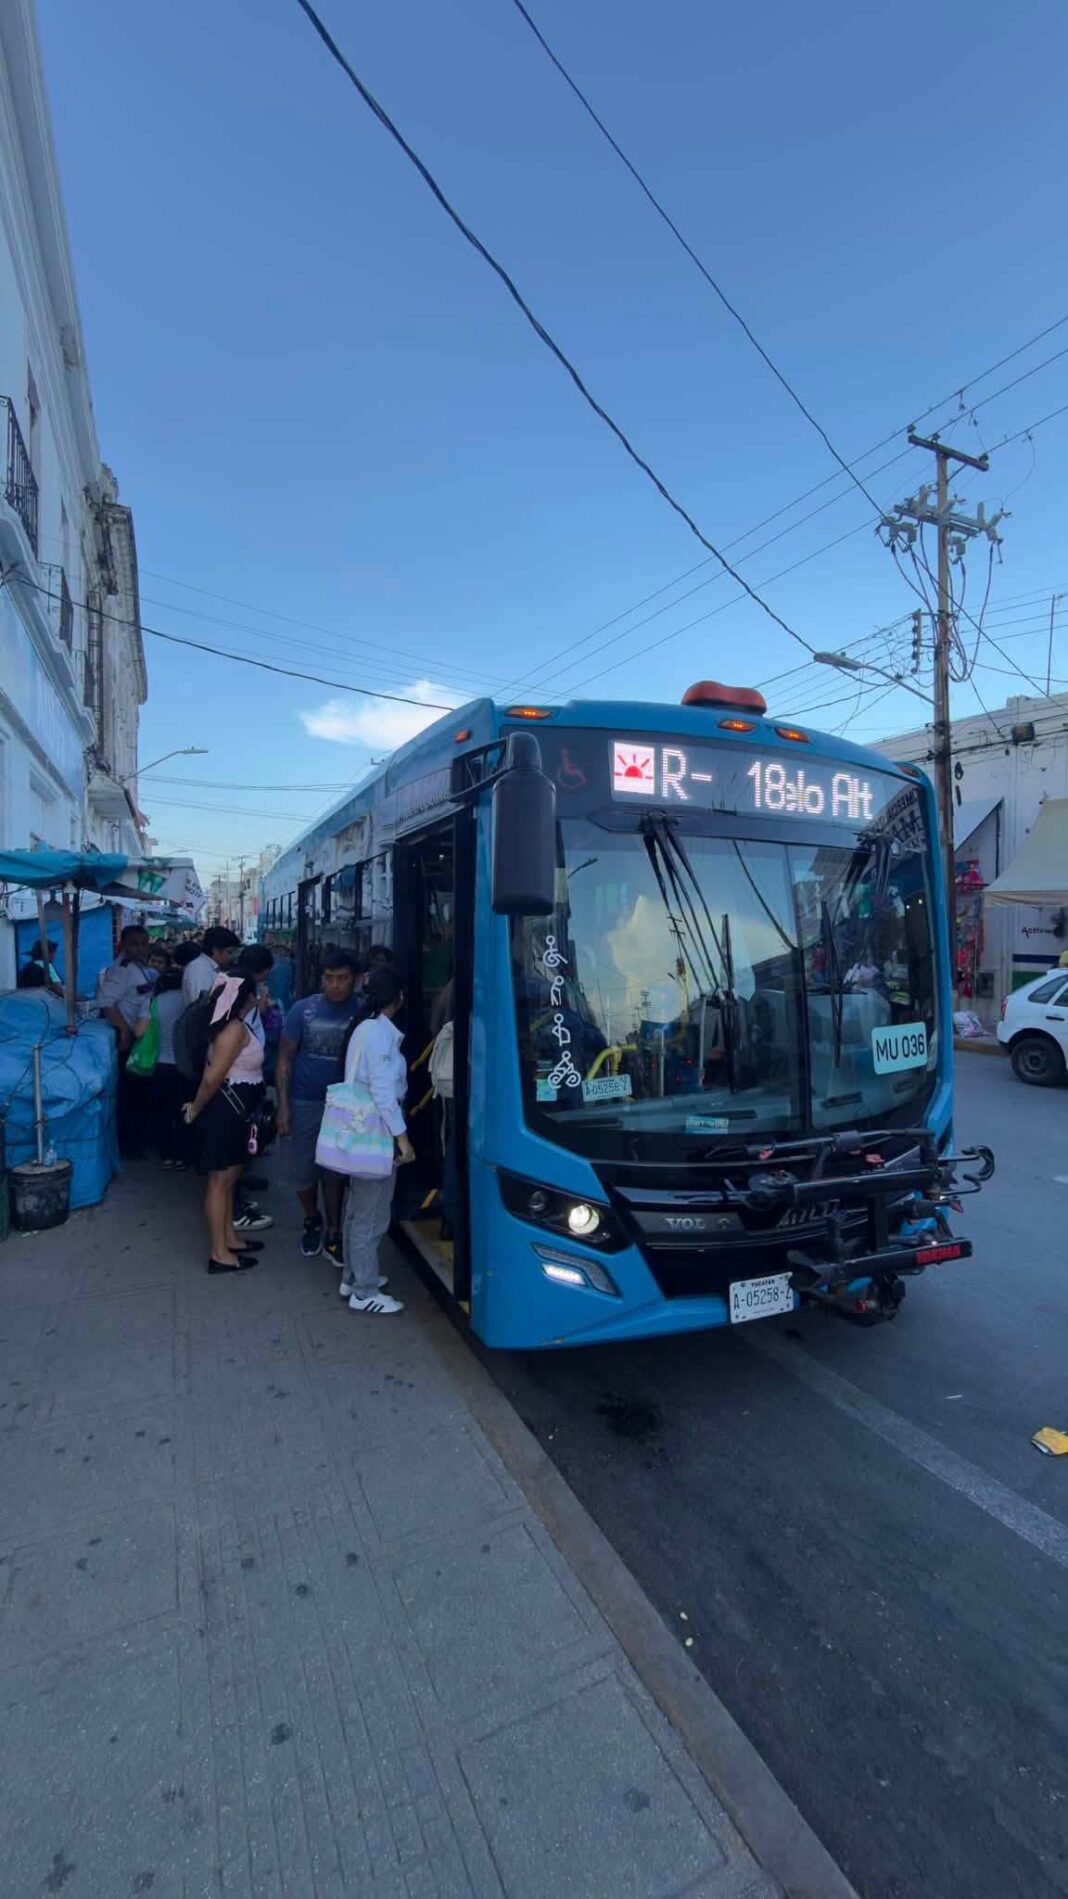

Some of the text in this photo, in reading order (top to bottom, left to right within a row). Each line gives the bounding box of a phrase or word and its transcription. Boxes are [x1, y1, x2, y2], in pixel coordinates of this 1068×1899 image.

[875, 1033, 926, 1062] MU 036
[734, 1286, 791, 1309] A-05258-Z
